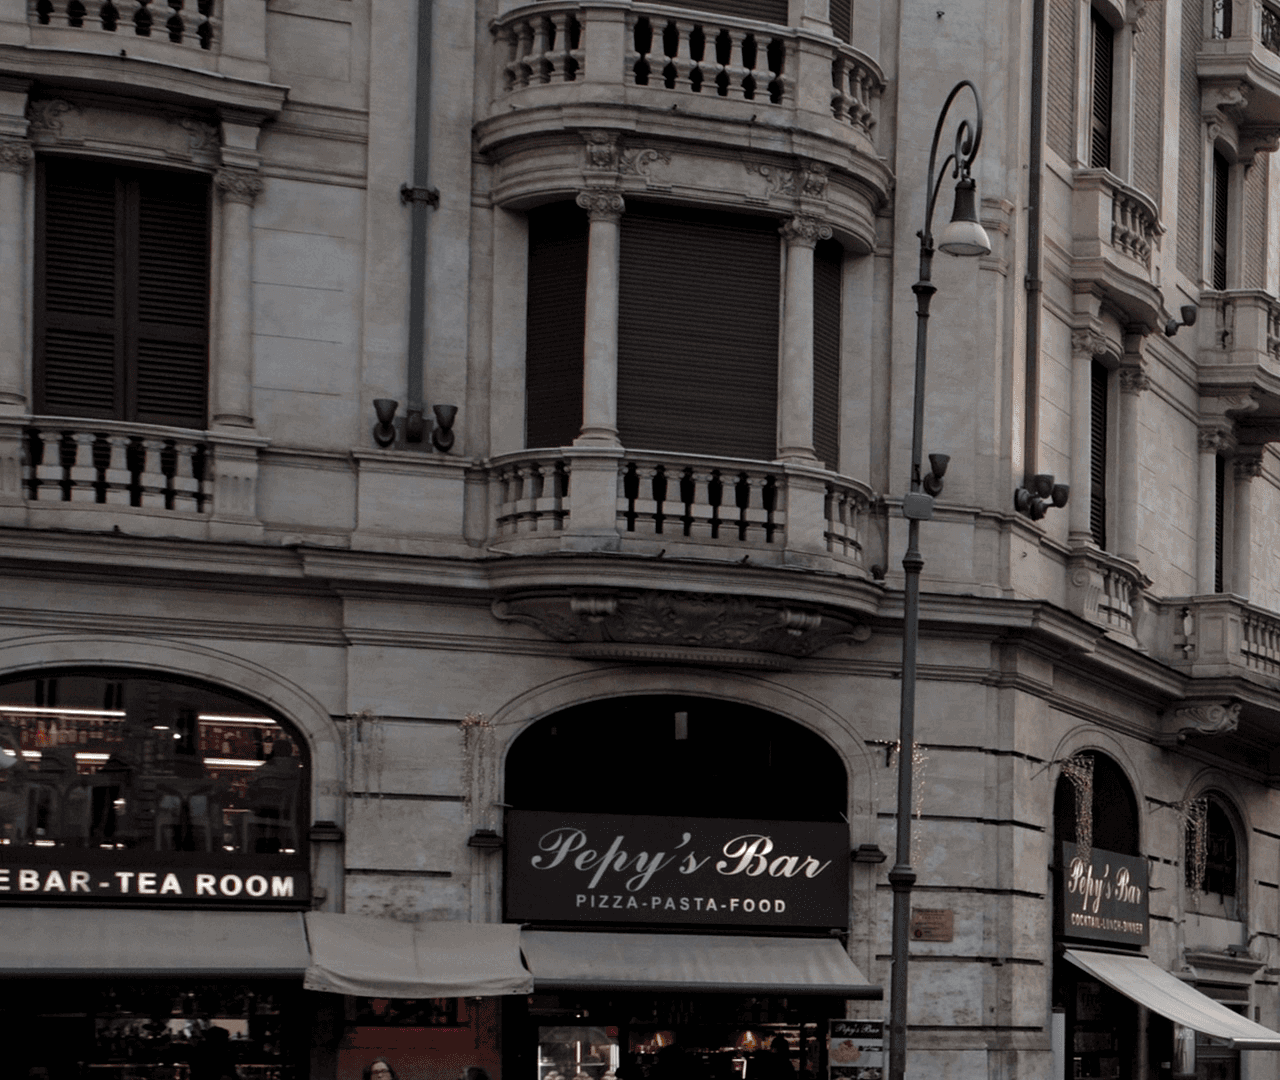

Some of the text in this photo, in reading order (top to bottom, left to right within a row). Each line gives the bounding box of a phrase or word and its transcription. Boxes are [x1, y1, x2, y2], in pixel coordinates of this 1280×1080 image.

[530, 827, 832, 892] Pepy's Bar
[196, 873, 294, 897] ROOM
[575, 893, 787, 915] PIZZA-PASTA-FOOD
[1068, 857, 1142, 914] Pepy's Bar
